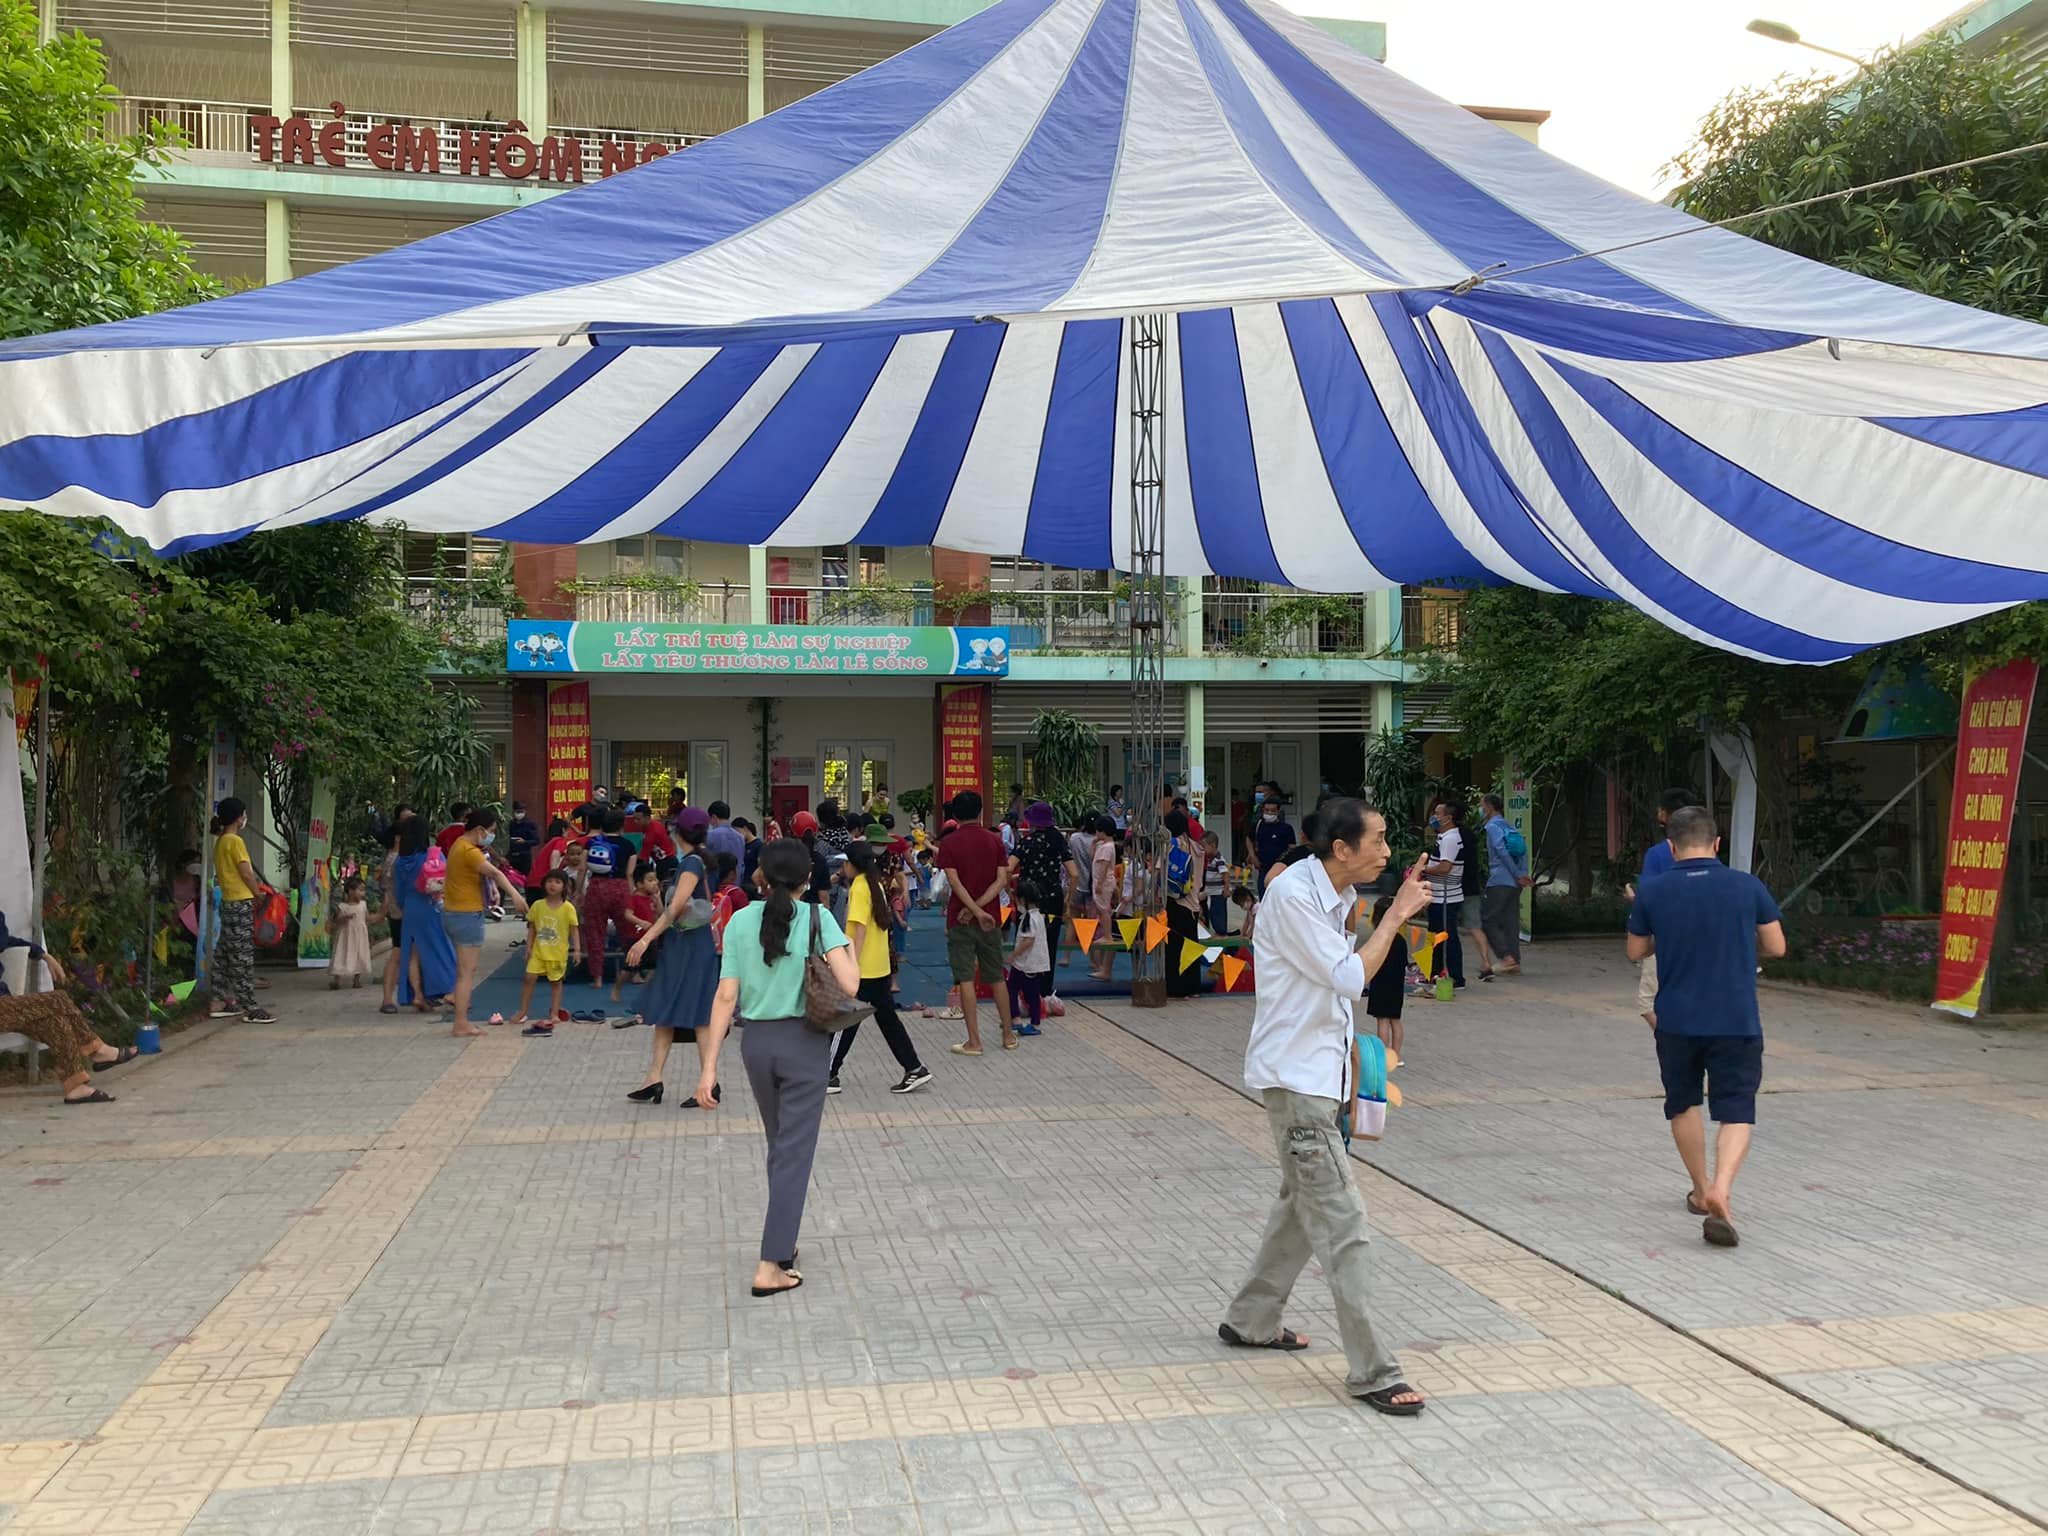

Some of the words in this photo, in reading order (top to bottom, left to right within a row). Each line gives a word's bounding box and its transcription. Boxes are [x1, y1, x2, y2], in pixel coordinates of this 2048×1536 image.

[250, 101, 346, 167] TRẺ
[366, 123, 440, 174] EM
[459, 119, 584, 183] HÔM
[615, 627, 659, 647] LẤY
[664, 631, 701, 648] TRÍ
[705, 630, 748, 652] TUỆ
[753, 631, 797, 649] LÀM
[802, 633, 830, 652] SỰ
[834, 633, 911, 652] NGHIỆP
[602, 648, 647, 668] LẤY
[651, 651, 697, 668] YÊU
[701, 653, 790, 669] THƯƠNG
[795, 653, 839, 670] LÀM
[873, 651, 928, 670] SỐNG
[1968, 747, 1988, 774] CHO
[553, 789, 567, 803] GIA
[1964, 794, 1979, 821] GIA
